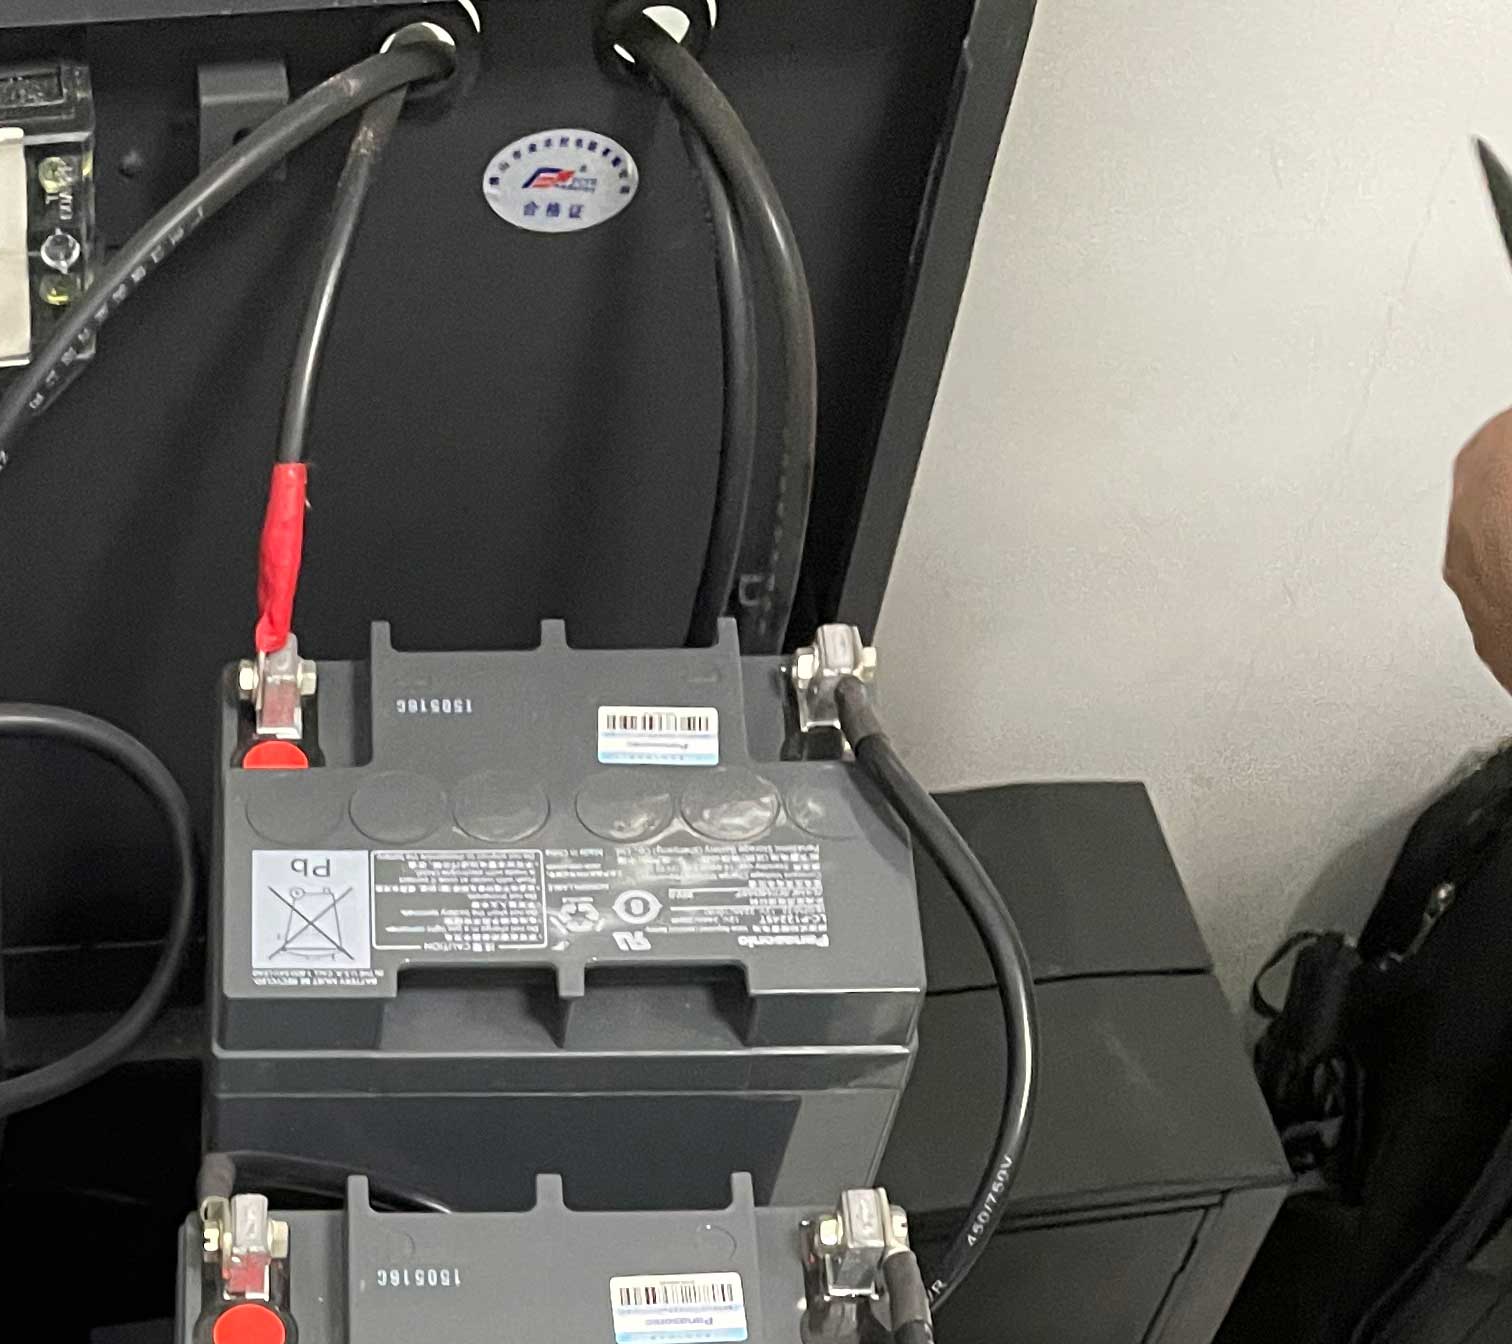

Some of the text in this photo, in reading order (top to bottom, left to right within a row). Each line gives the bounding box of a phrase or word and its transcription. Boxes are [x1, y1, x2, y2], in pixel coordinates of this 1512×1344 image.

[290, 856, 329, 878] Pb
[423, 940, 470, 952] CAUTION
[737, 932, 828, 949] Panasonic
[643, 1315, 713, 1328] Panasonic
